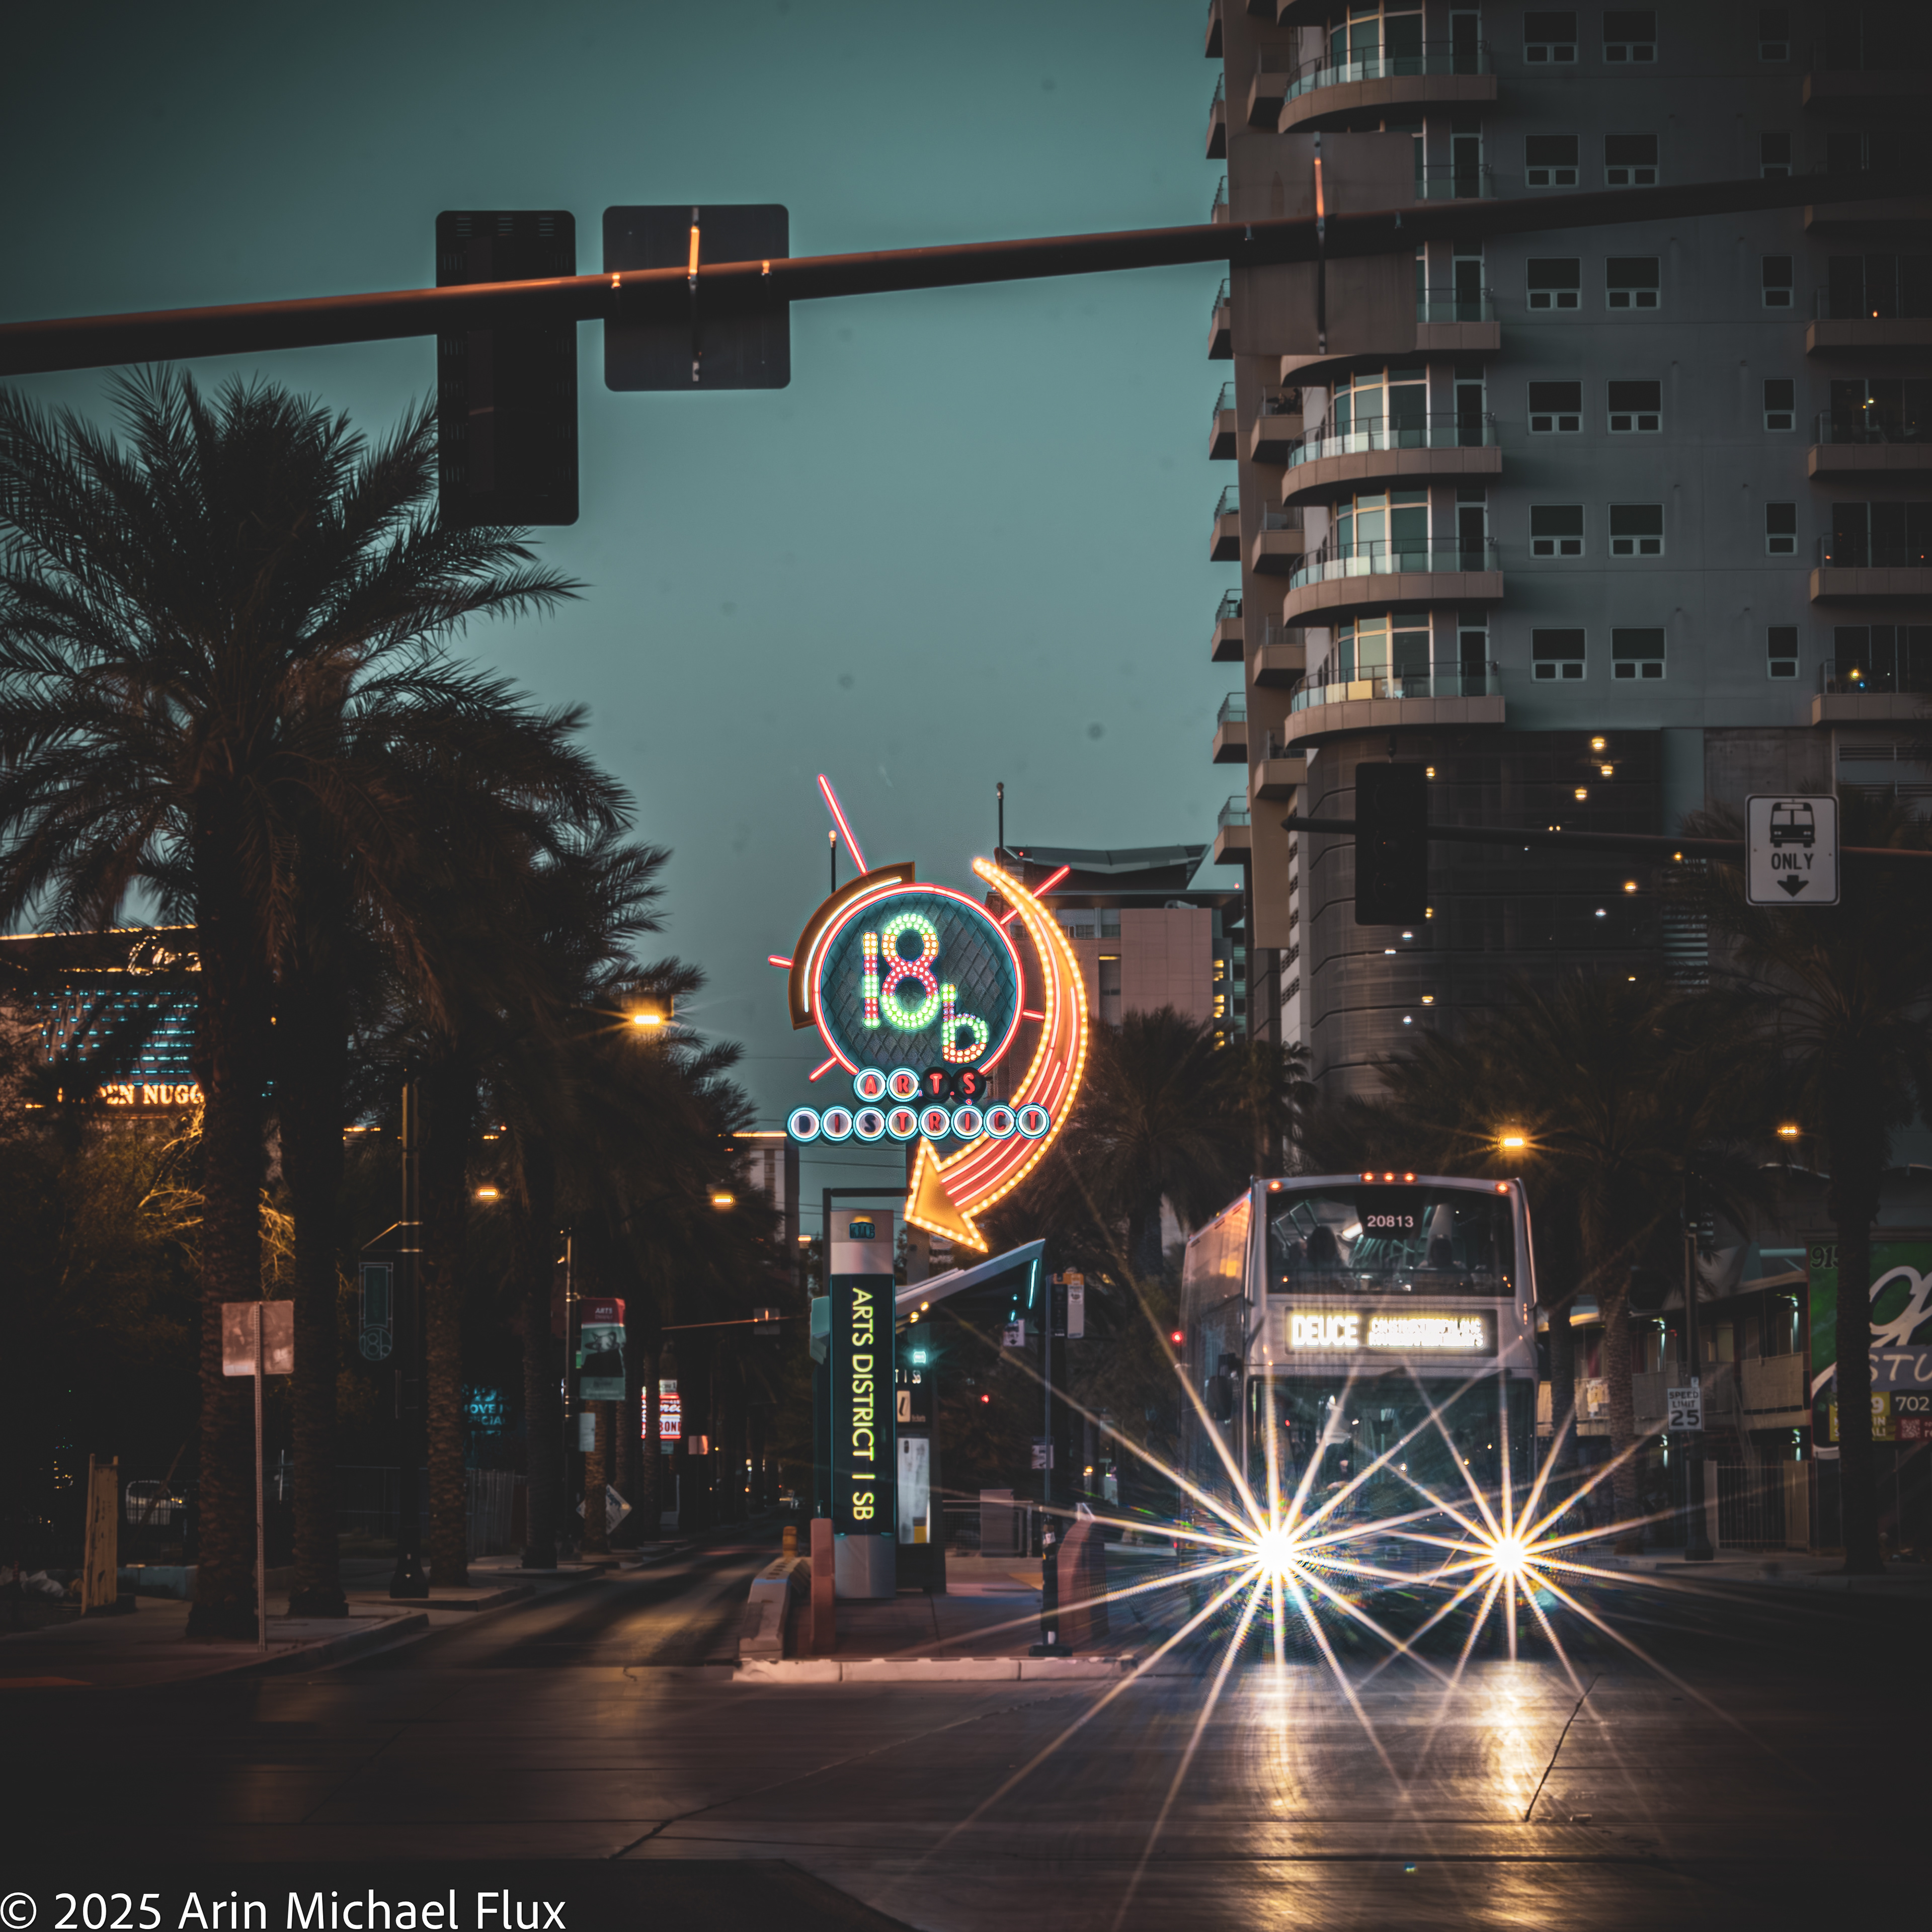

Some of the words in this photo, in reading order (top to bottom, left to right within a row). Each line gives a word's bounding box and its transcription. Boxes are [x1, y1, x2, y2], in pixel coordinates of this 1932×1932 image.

[1771, 852, 1814, 870] ONLY
[863, 914, 987, 1063] 18b
[862, 1071, 977, 1097] ARTS
[796, 1109, 1041, 1136] DISTRICT
[1367, 1215, 1414, 1228] 20813
[852, 1287, 873, 1347] ARTS
[1292, 1316, 1358, 1346] DEUCE
[852, 1355, 874, 1461] DISTRICT
[1895, 1396, 1930, 1411] 702
[1671, 1410, 1699, 1426] 25
[852, 1492, 874, 1520] SB
